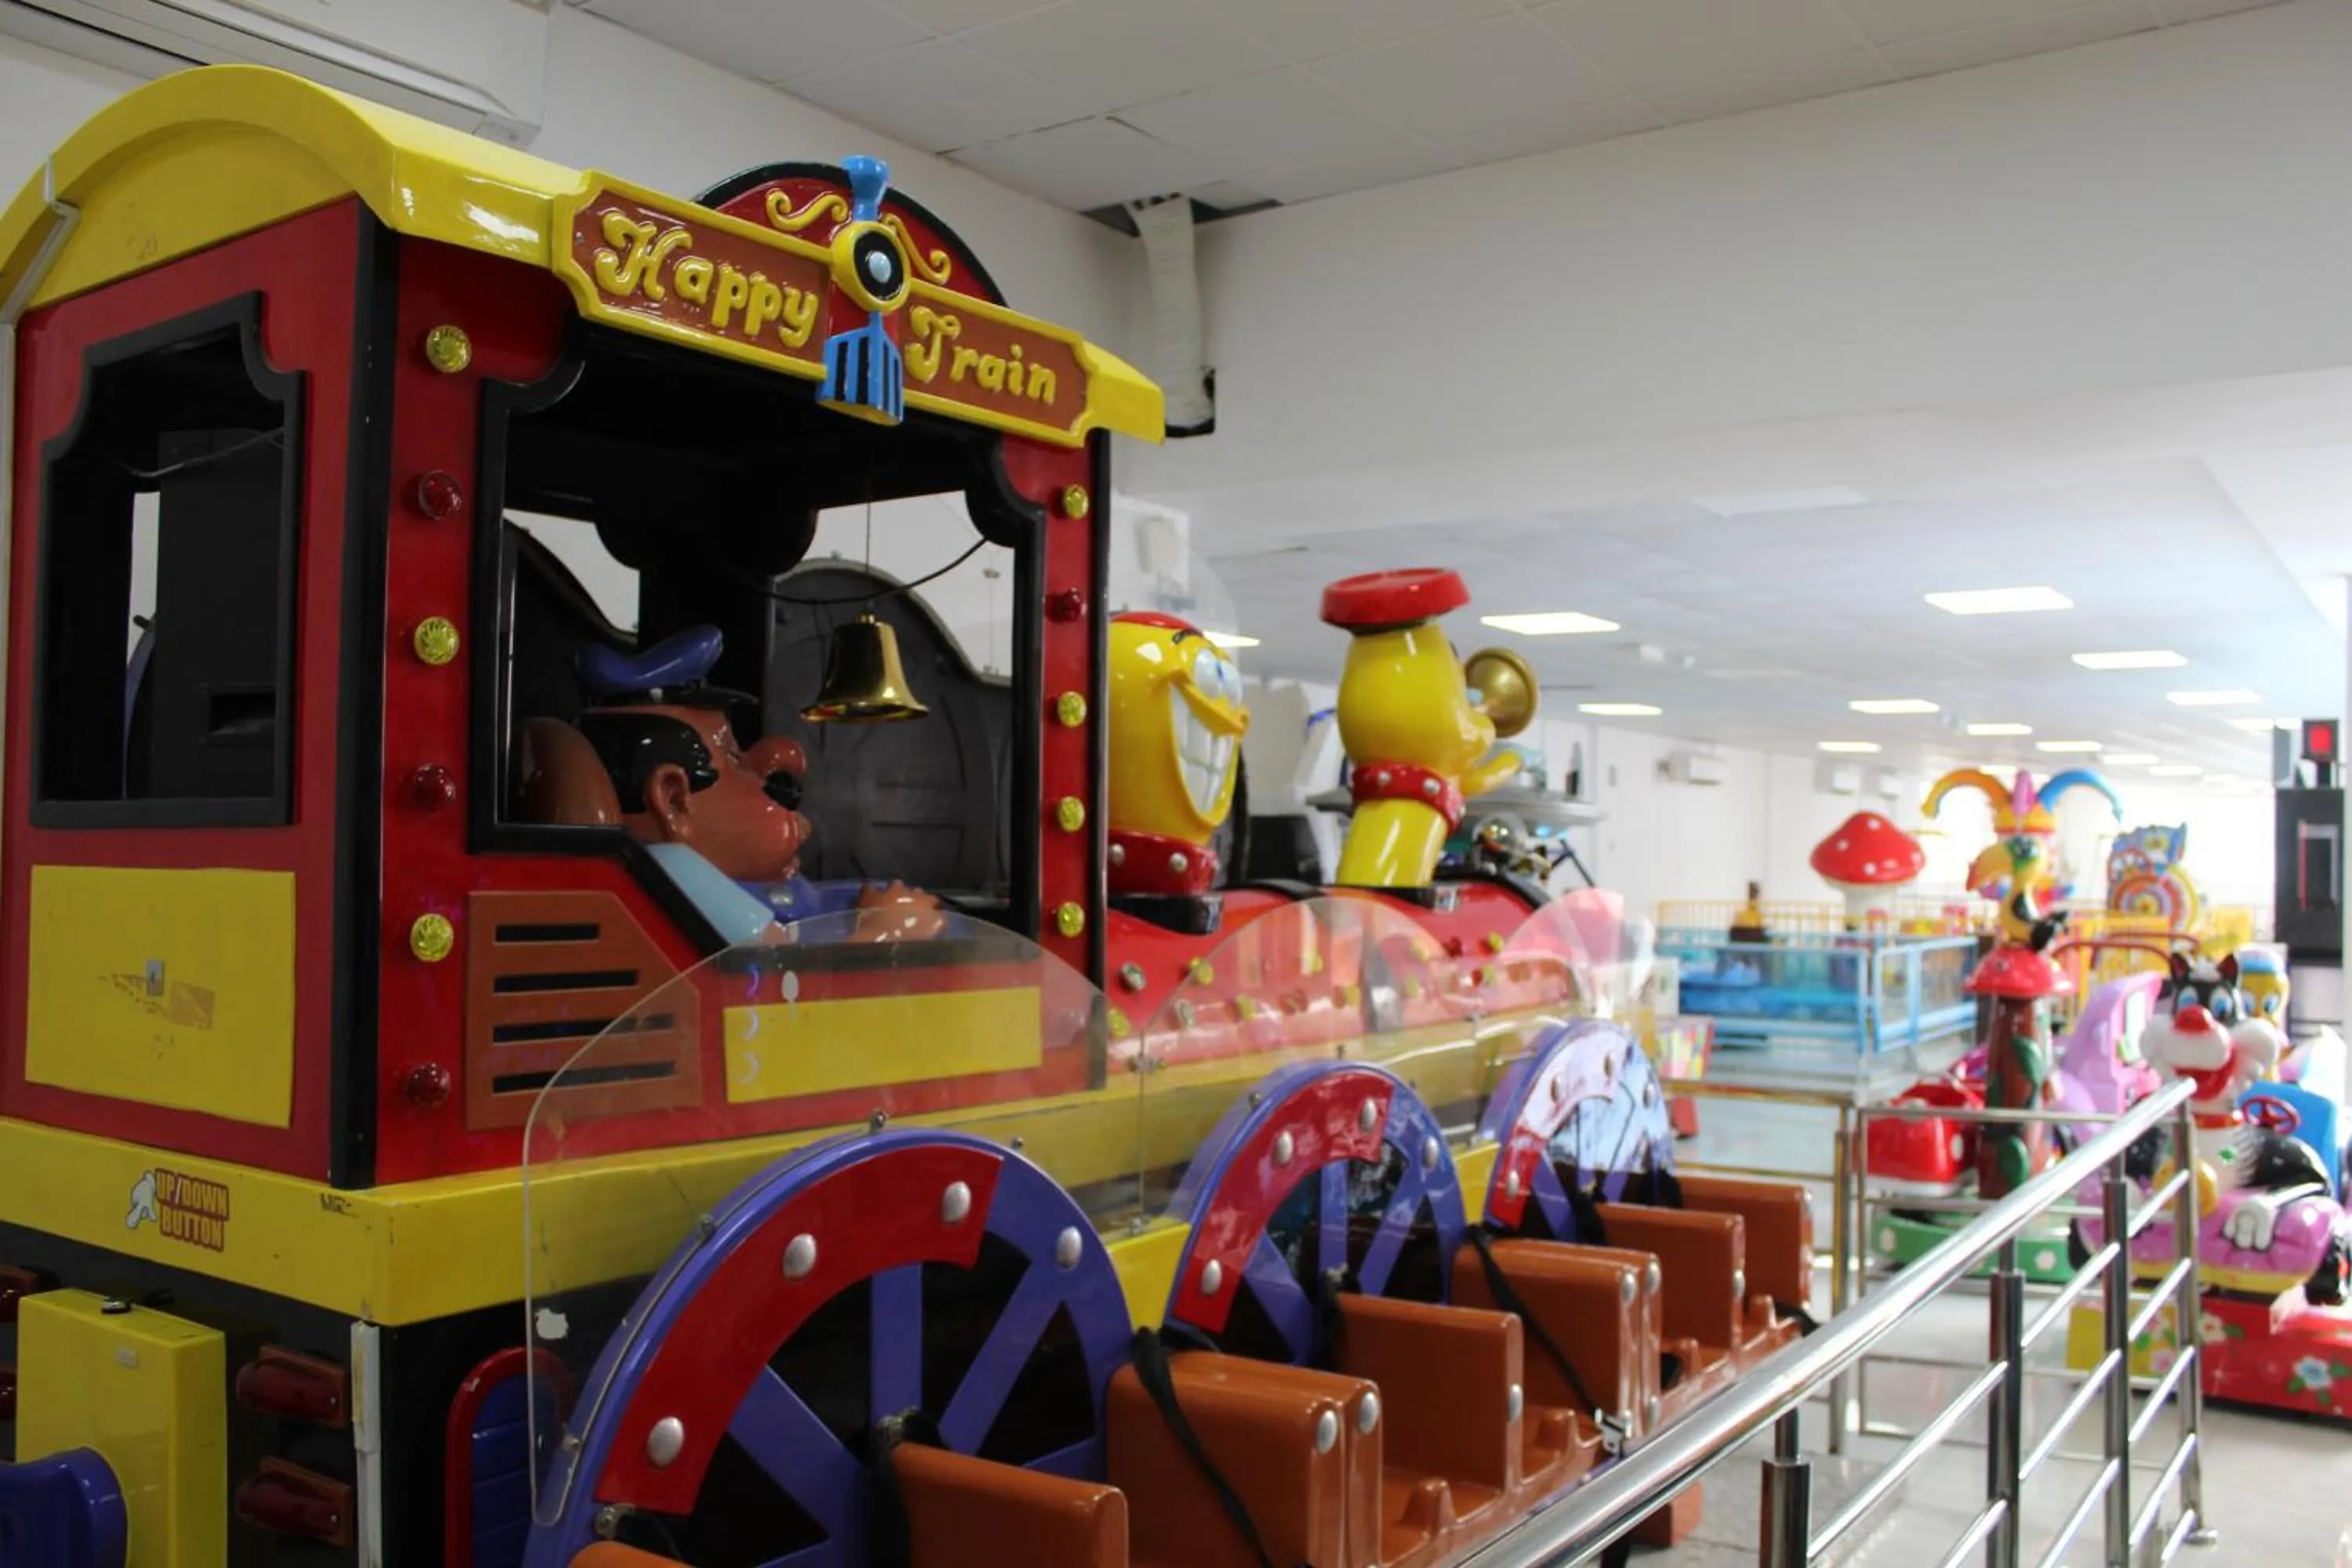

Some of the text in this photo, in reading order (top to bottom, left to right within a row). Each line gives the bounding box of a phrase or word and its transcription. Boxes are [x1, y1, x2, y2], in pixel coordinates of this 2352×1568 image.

[596, 209, 1056, 404] Happy Train
[157, 1169, 229, 1218] UP/DOWN
[161, 1207, 224, 1250] BUTTON
